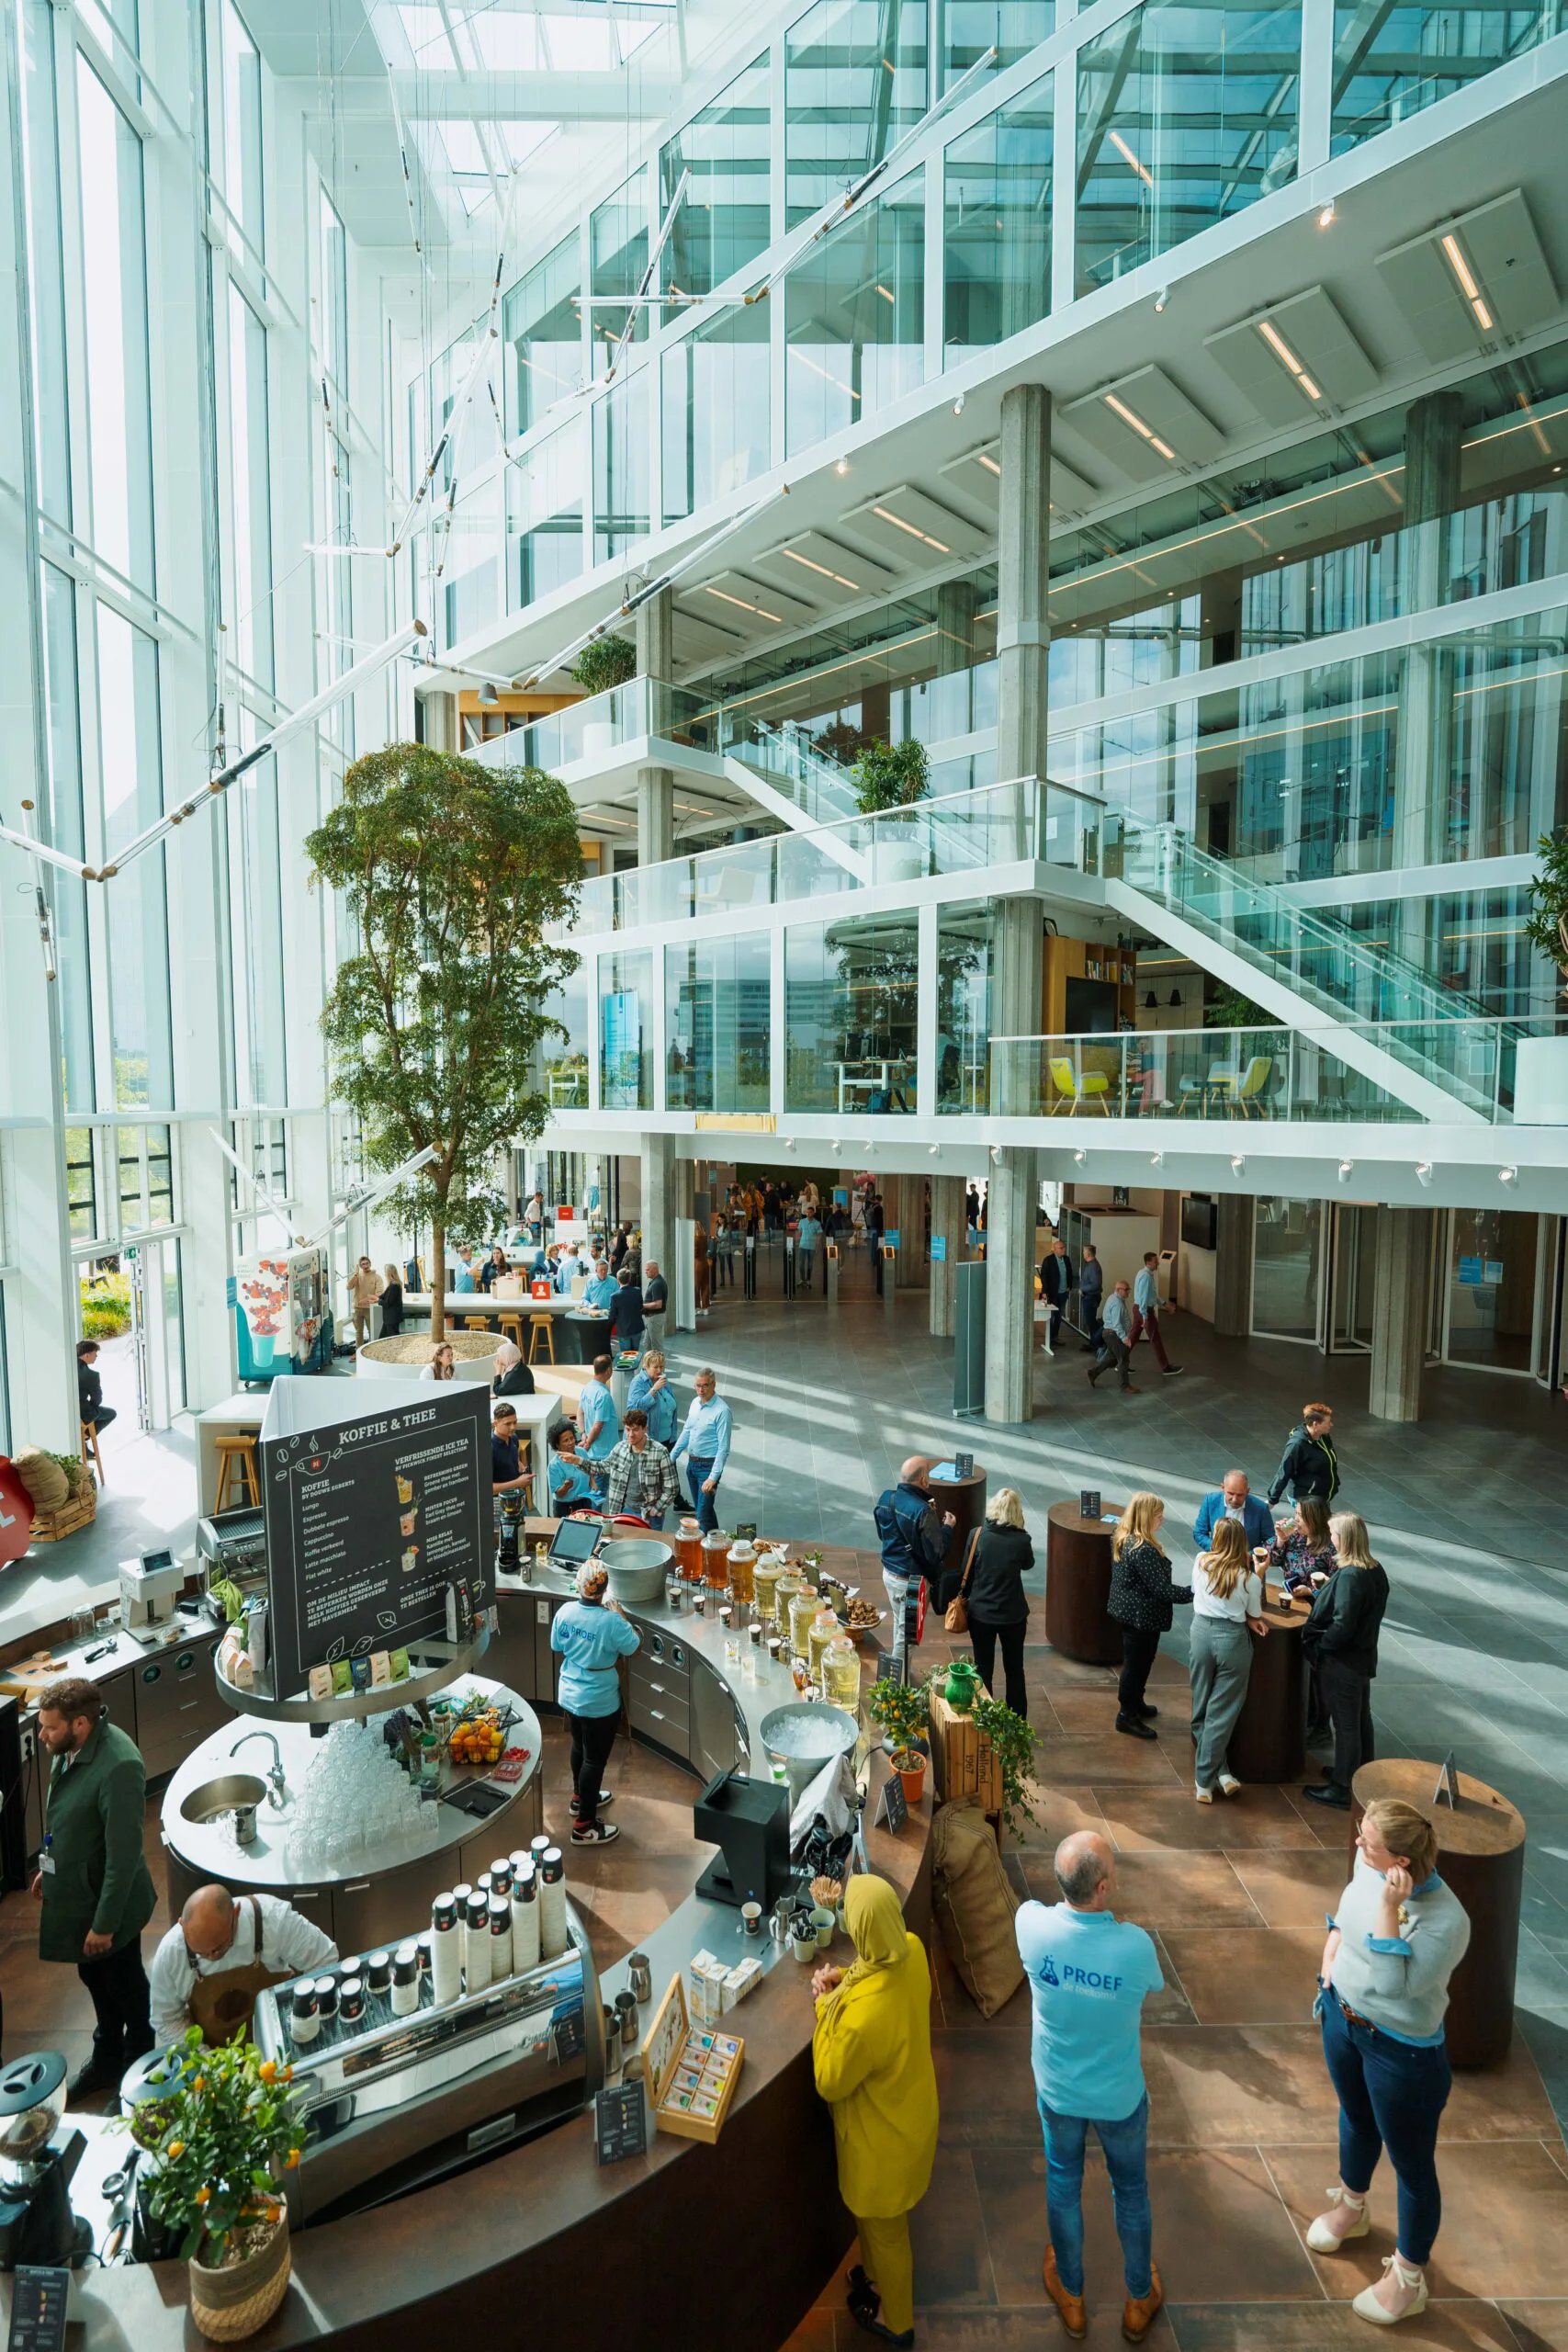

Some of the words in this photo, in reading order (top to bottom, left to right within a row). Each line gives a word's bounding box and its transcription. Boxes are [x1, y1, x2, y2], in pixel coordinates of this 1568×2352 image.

[339, 1420, 388, 1445] KOFFIE
[390, 1419, 400, 1430] &
[403, 1408, 436, 1427] THEE
[395, 1445, 445, 1465] VERFRISSENDE
[446, 1442, 456, 1450] ICE
[457, 1438, 468, 1447] TEA
[402, 1458, 425, 1469] PICKWICK
[426, 1453, 442, 1462] FINEST
[444, 1445, 467, 1456] SELECTION
[423, 1468, 453, 1481] REFRESHING
[454, 1463, 468, 1471] GREEN
[301, 1479, 330, 1493] KOFFIE
[310, 1487, 331, 1498] DOUWE
[332, 1479, 355, 1491] EGBERTS
[302, 1502, 319, 1511] Lungo
[425, 1503, 443, 1512] MISTER
[444, 1497, 457, 1506] FOCUS
[302, 1511, 327, 1523] Espresso
[303, 1522, 325, 1534] Dubbele
[326, 1516, 350, 1527] espresso
[304, 1532, 334, 1545] Cappuccino
[438, 1530, 453, 1539] RELAX
[304, 1547, 320, 1557] Koffie
[321, 1540, 344, 1551] verkeerd
[305, 1560, 319, 1569] Latte
[320, 1551, 346, 1564] macchiato
[306, 1572, 316, 1580] Flat
[317, 1567, 332, 1577] white
[307, 1600, 317, 1608] OM
[318, 1596, 326, 1604] DE
[327, 1589, 348, 1600] MILIEU
[349, 1579, 370, 1592] IMPACT
[316, 1595, 347, 1611] BEPERKEN
[348, 1586, 373, 1598] WORDEN
[374, 1578, 389, 1589] ONZE
[400, 1594, 415, 1603] ONZE
[415, 1589, 428, 1597] THEE
[435, 1580, 446, 1589] OOK
[408, 1591, 436, 1607] BESTELLEN
[308, 1611, 324, 1622] MELK
[326, 1602, 350, 1614] KOFFIES
[350, 1586, 387, 1603] GESERVEERD
[308, 1619, 321, 1629] MET
[322, 1605, 357, 1623] HAVERMELK
[571, 1625, 597, 1641] PROEF
[965, 1754, 975, 1774] 1967
[979, 1745, 989, 1783] Holland
[1063, 1982, 1074, 1991] de
[1064, 1964, 1122, 1991] PROEF
